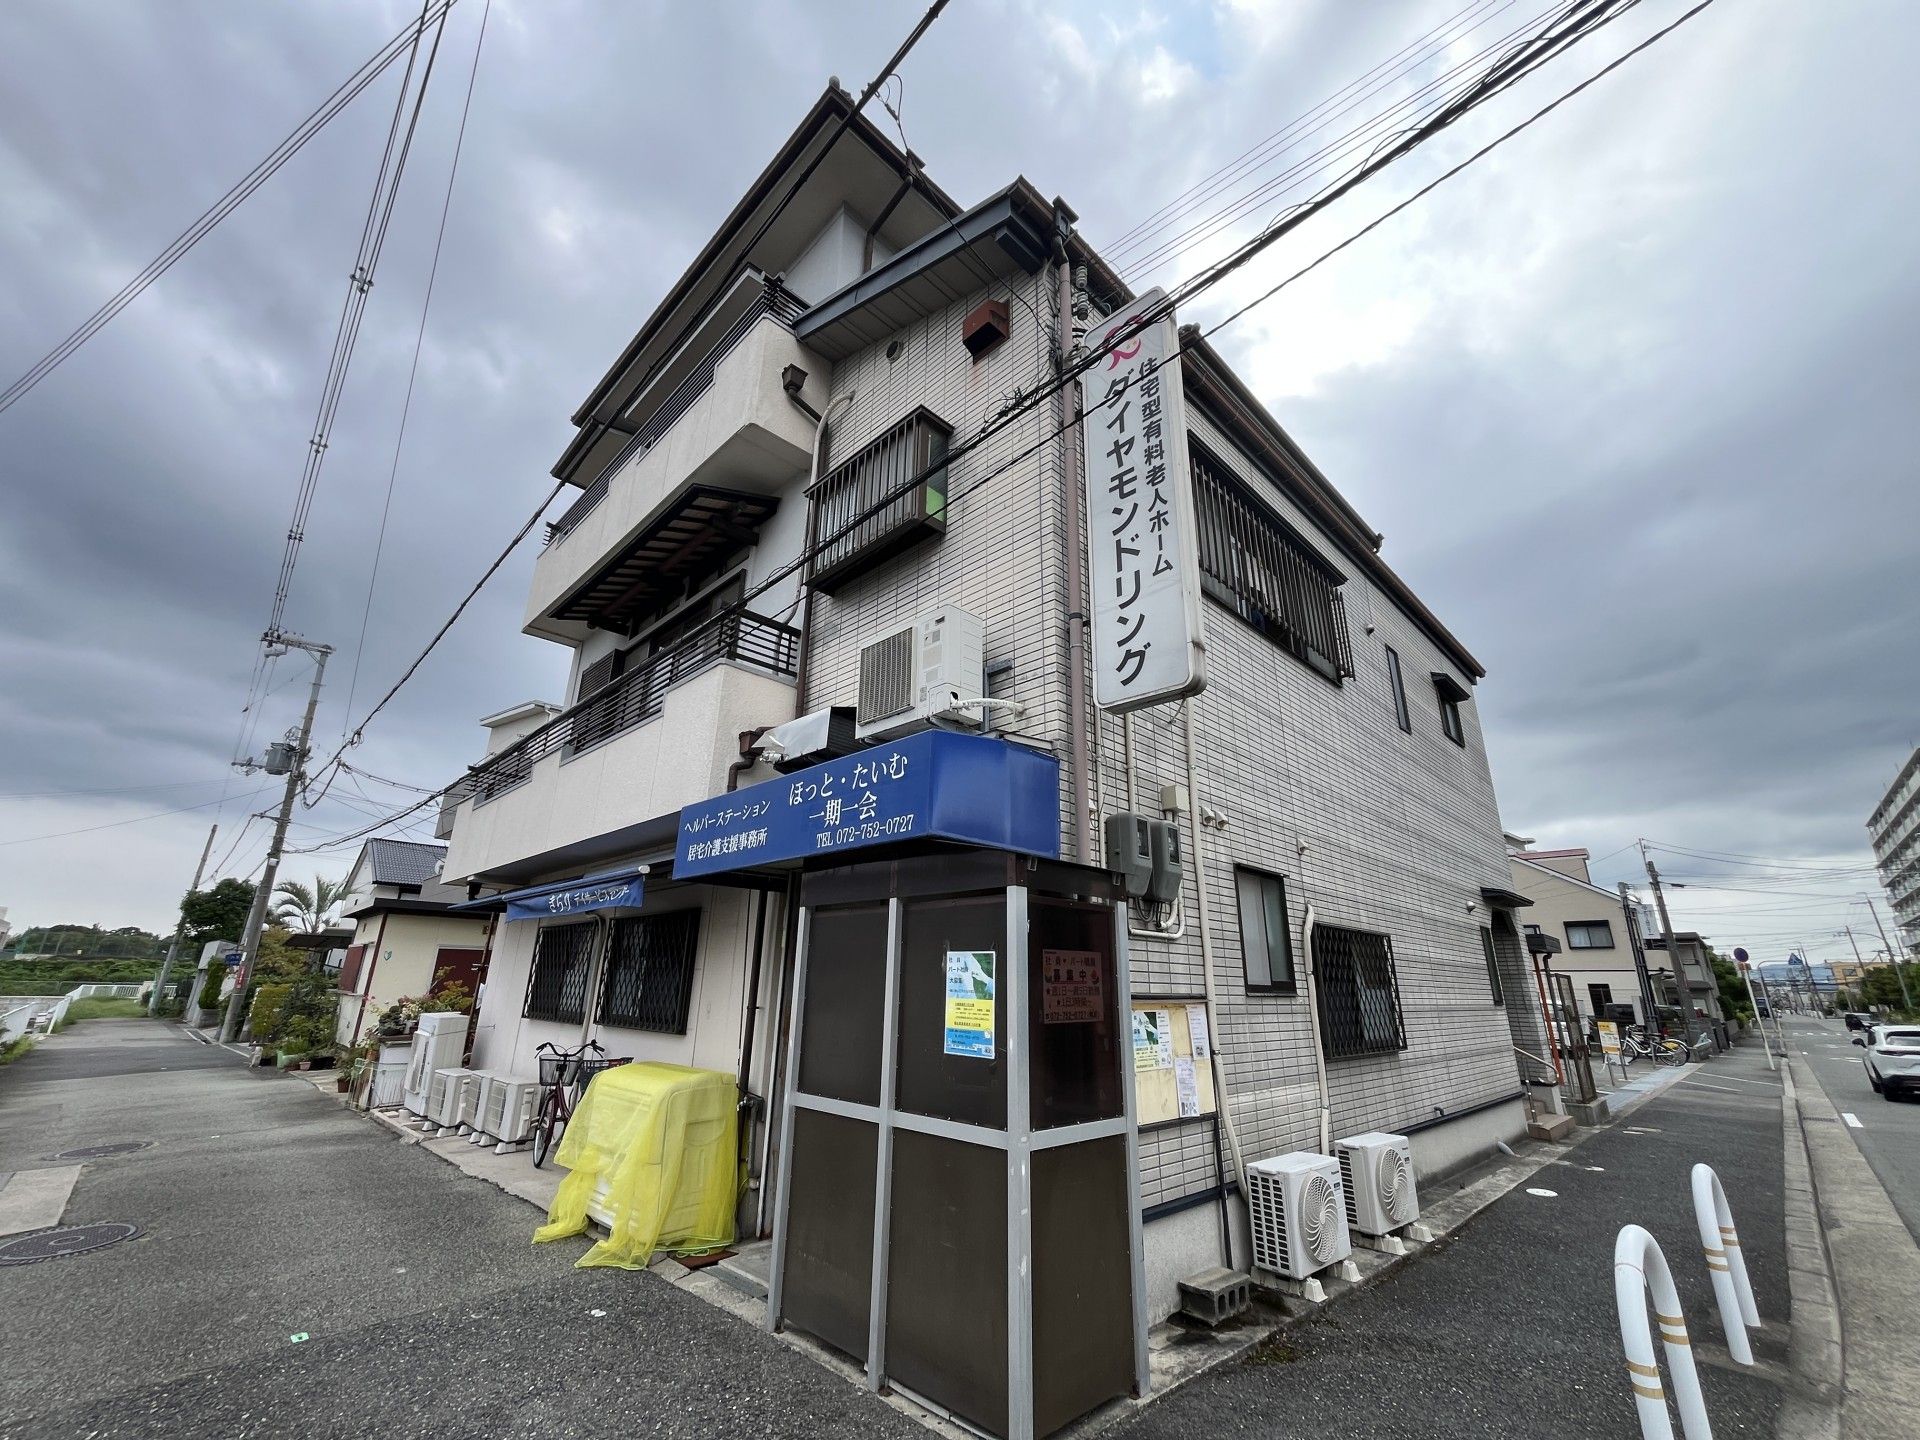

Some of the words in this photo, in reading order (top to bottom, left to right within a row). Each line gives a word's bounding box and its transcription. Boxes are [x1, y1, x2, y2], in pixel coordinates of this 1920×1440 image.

[1138, 357, 1174, 577] 住宅型有料老人ホーム
[1104, 368, 1152, 687] ダイヤモンドリング
[789, 752, 908, 806] ほっと・たいむ
[684, 800, 771, 833] ヘルパーステーション
[808, 791, 878, 828] 一期一会
[686, 827, 768, 862] 居宅介護支援事務所
[816, 831, 834, 849] TEL
[836, 813, 914, 844] 072-752-0727
[548, 891, 571, 913] きらり
